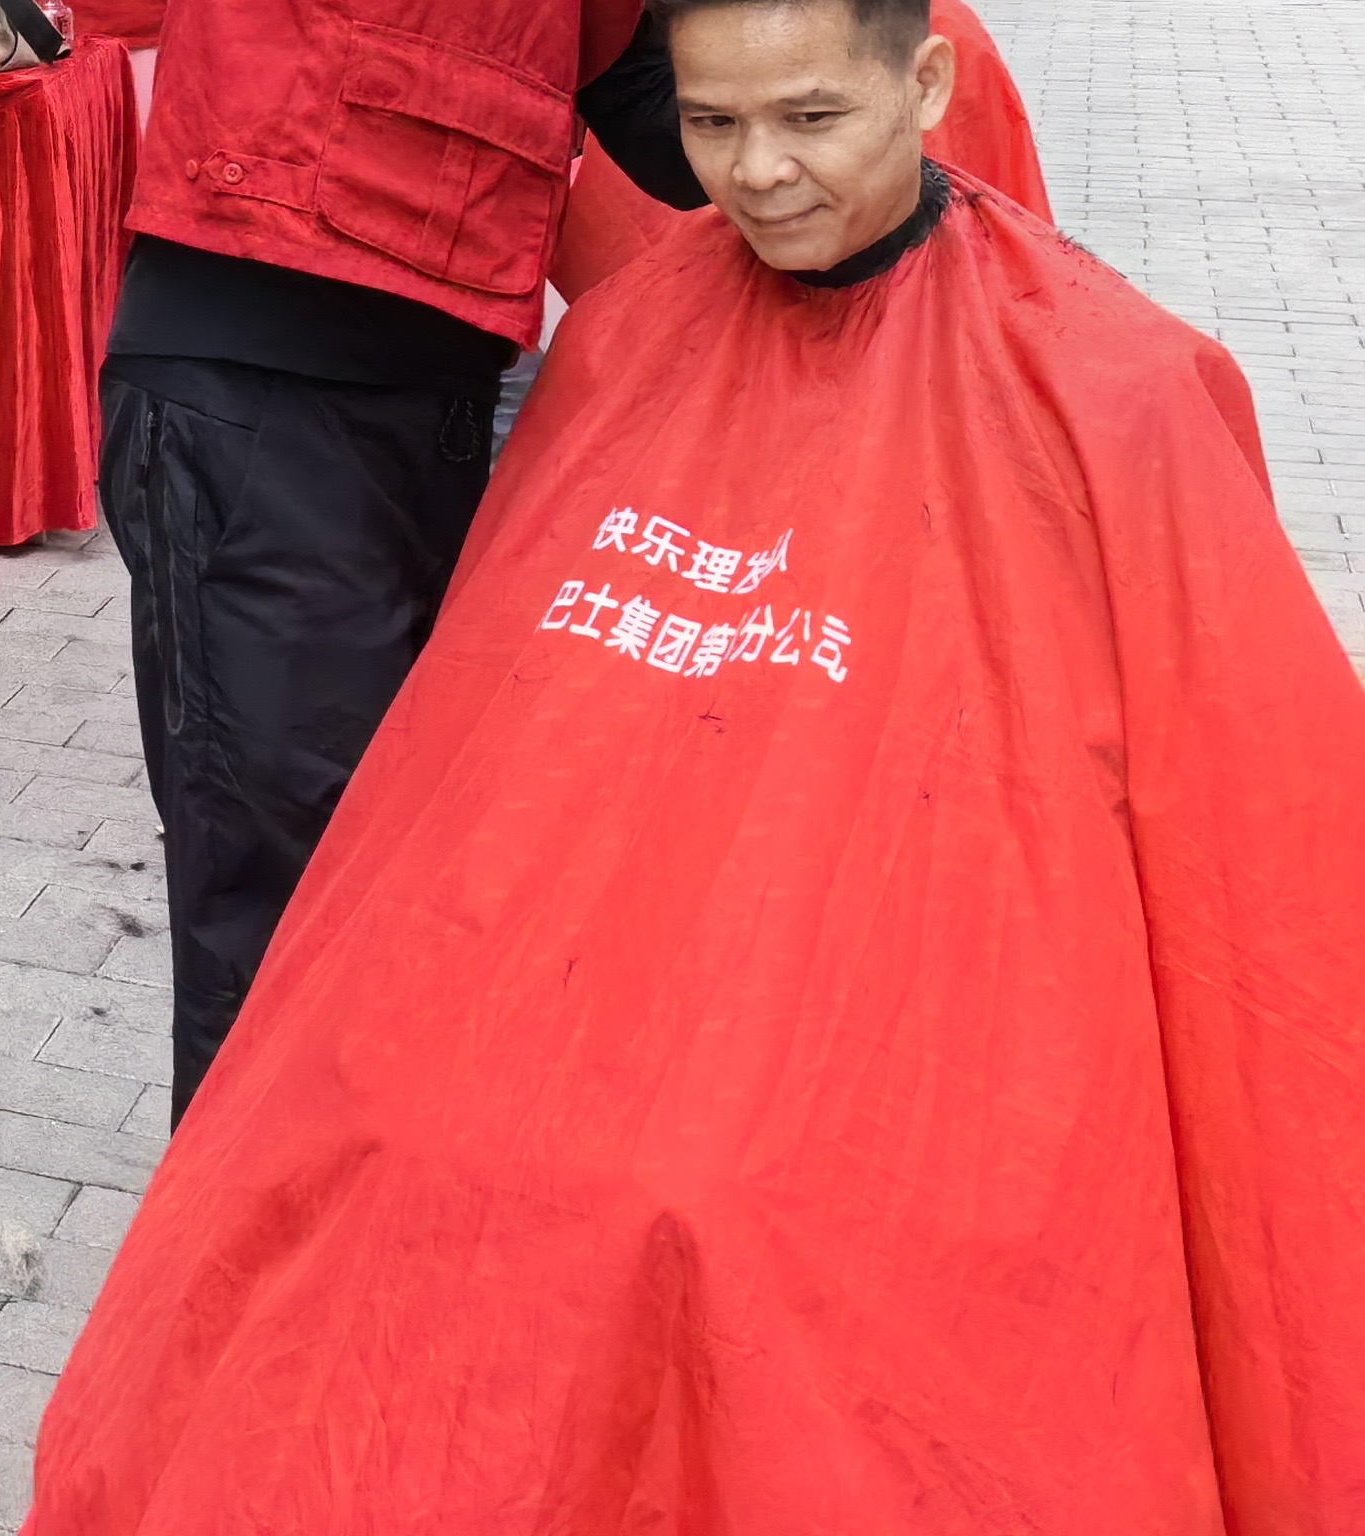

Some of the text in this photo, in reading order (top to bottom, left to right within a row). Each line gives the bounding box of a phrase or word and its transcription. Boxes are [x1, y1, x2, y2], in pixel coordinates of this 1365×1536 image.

[538, 579, 852, 683] 巴士集团第分公司
